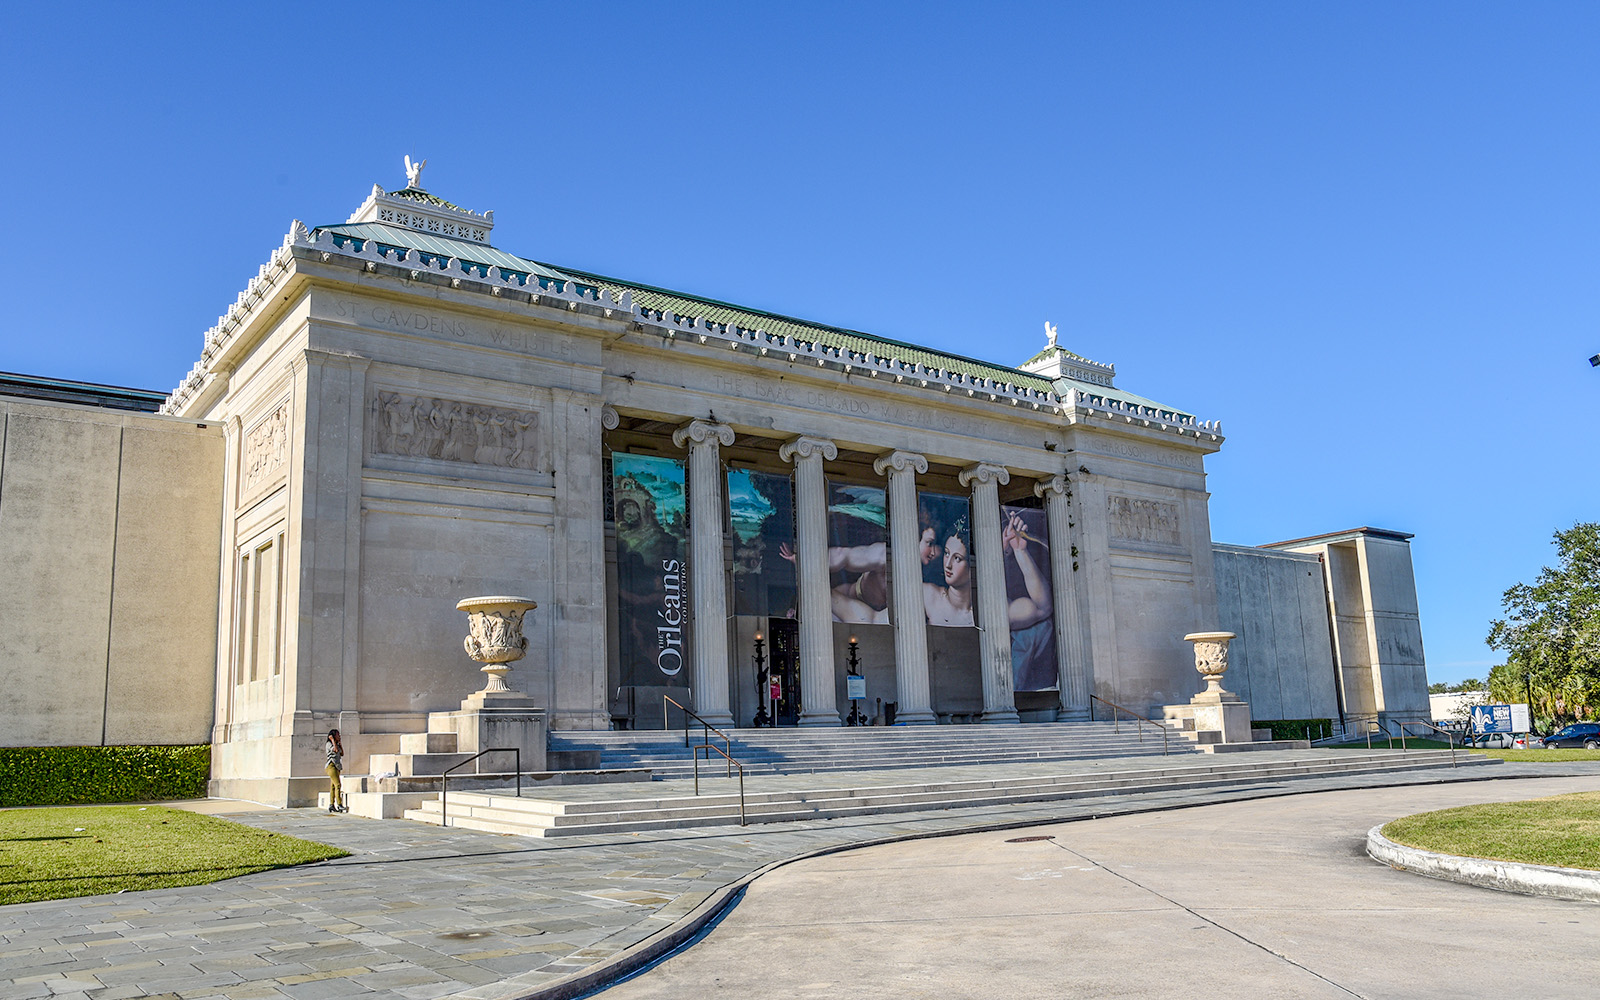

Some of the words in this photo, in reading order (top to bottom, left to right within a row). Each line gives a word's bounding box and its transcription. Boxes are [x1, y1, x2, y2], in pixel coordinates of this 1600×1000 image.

[335, 300, 360, 318] ST
[713, 375, 742, 393] THE
[755, 382, 795, 401] ISAAC
[807, 391, 870, 414] DELGADO
[657, 560, 682, 676] Orléans
